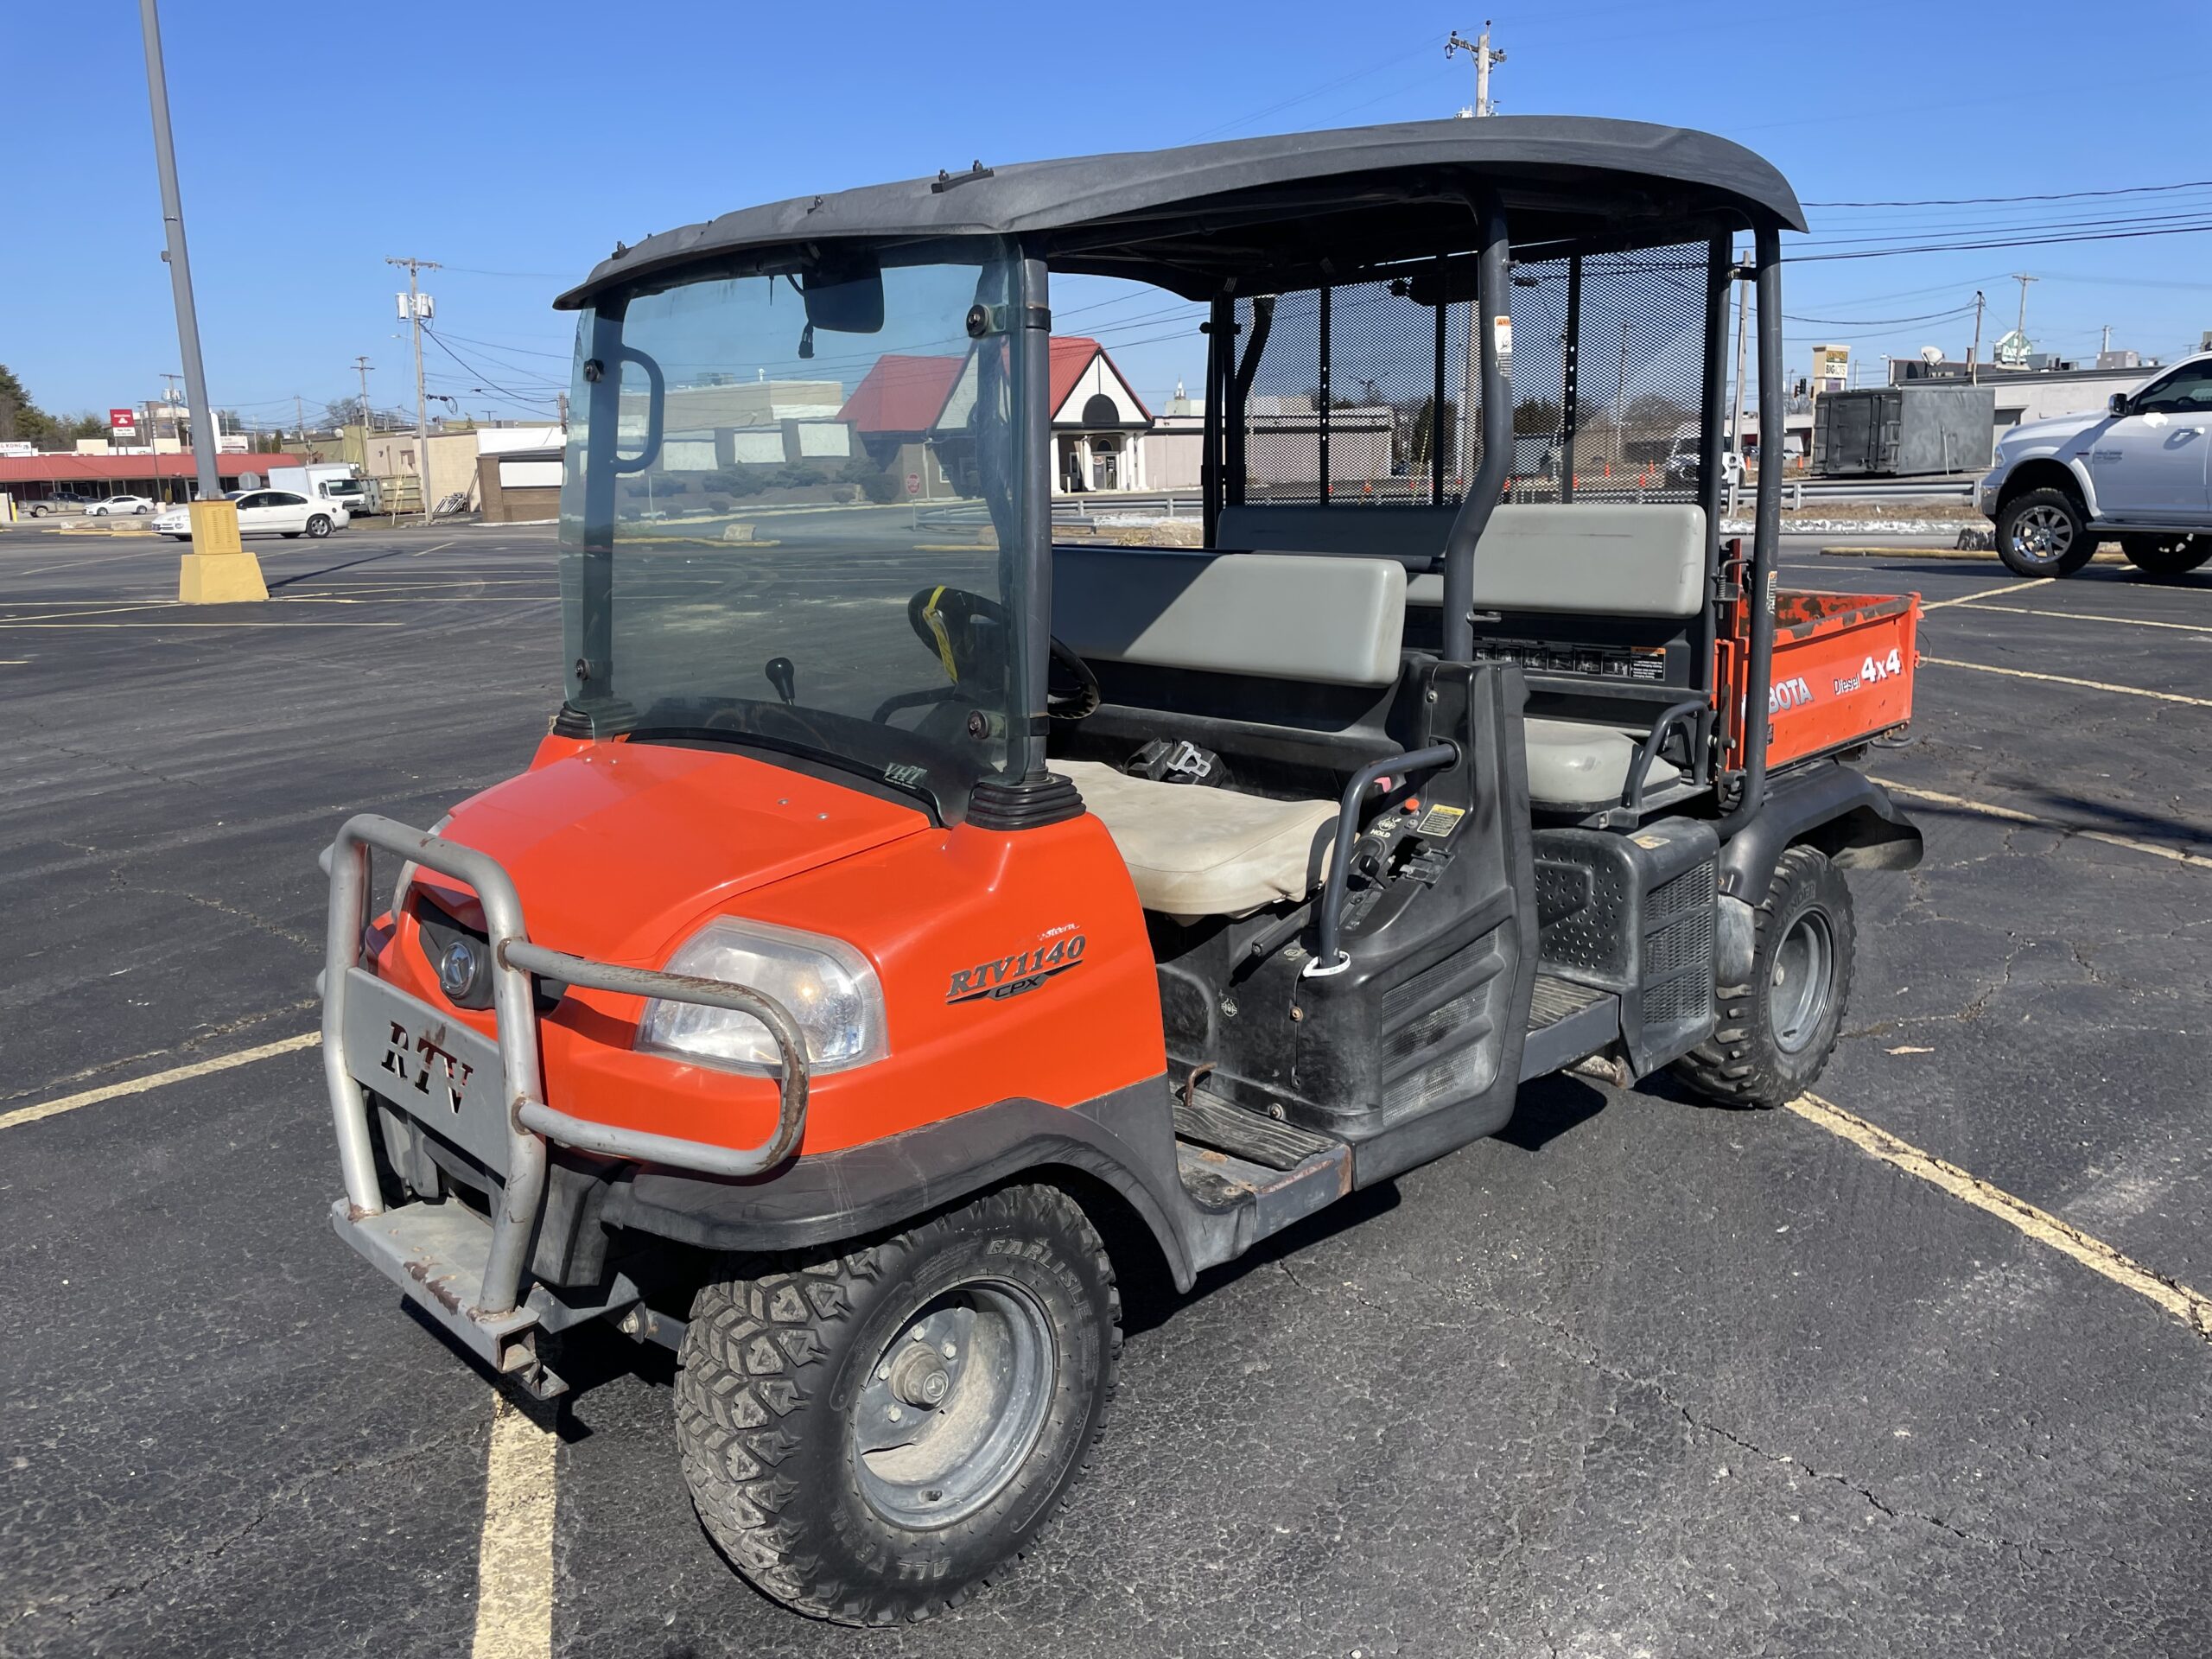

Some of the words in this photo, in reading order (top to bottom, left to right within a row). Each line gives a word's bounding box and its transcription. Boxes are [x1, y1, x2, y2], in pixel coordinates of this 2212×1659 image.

[1860, 648, 1902, 683] 4x4
[1833, 673, 1861, 696] Diesel
[1370, 829, 1391, 838] HOLD
[946, 935, 1086, 998] RTV1140
[995, 975, 1041, 998] CPX
[381, 1020, 474, 1114] RTV
[987, 1238, 1092, 1319] CARLISLE
